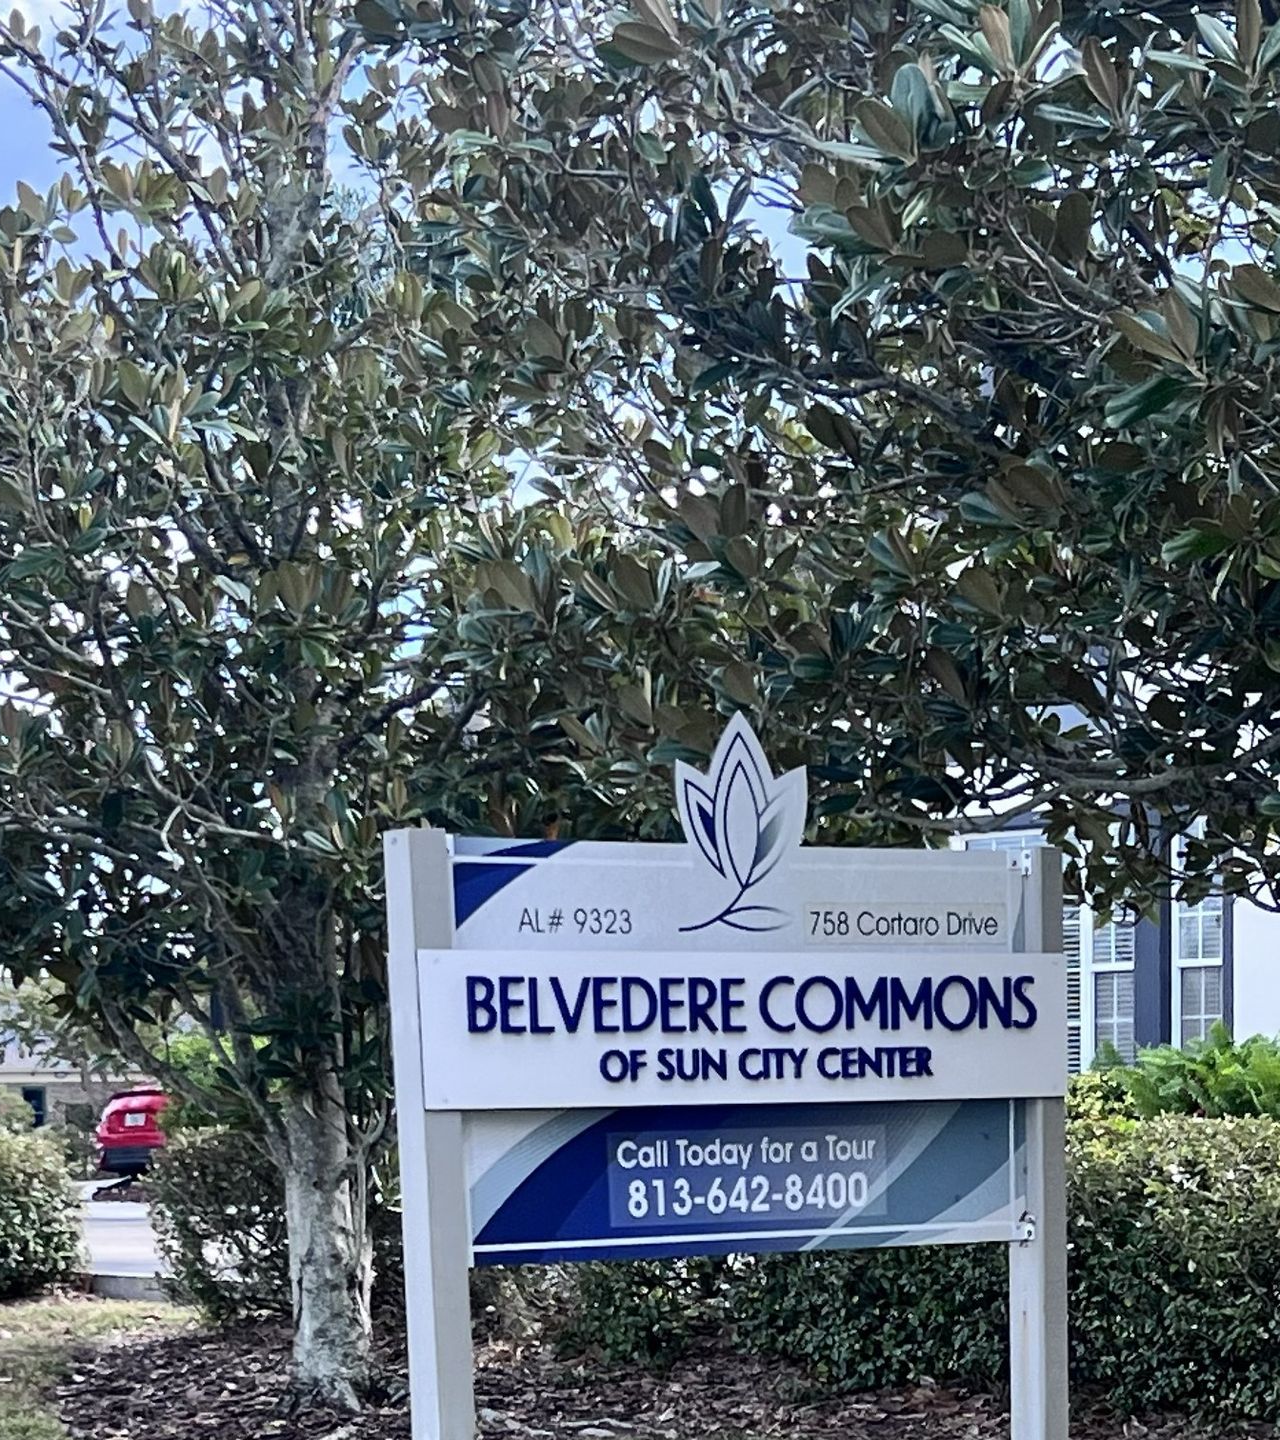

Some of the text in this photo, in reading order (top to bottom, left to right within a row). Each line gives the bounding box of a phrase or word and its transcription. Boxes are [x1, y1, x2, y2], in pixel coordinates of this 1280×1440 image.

[518, 907, 632, 934] AL# 9323
[810, 911, 998, 936] 758 Cortaro Drive
[466, 975, 1037, 1034] BELVEDERE COMMONS
[600, 1046, 933, 1082] OF SUN CITY CENTER
[617, 1135, 875, 1169] Call Today for a Tour
[628, 1172, 868, 1217] 813-642-8400
